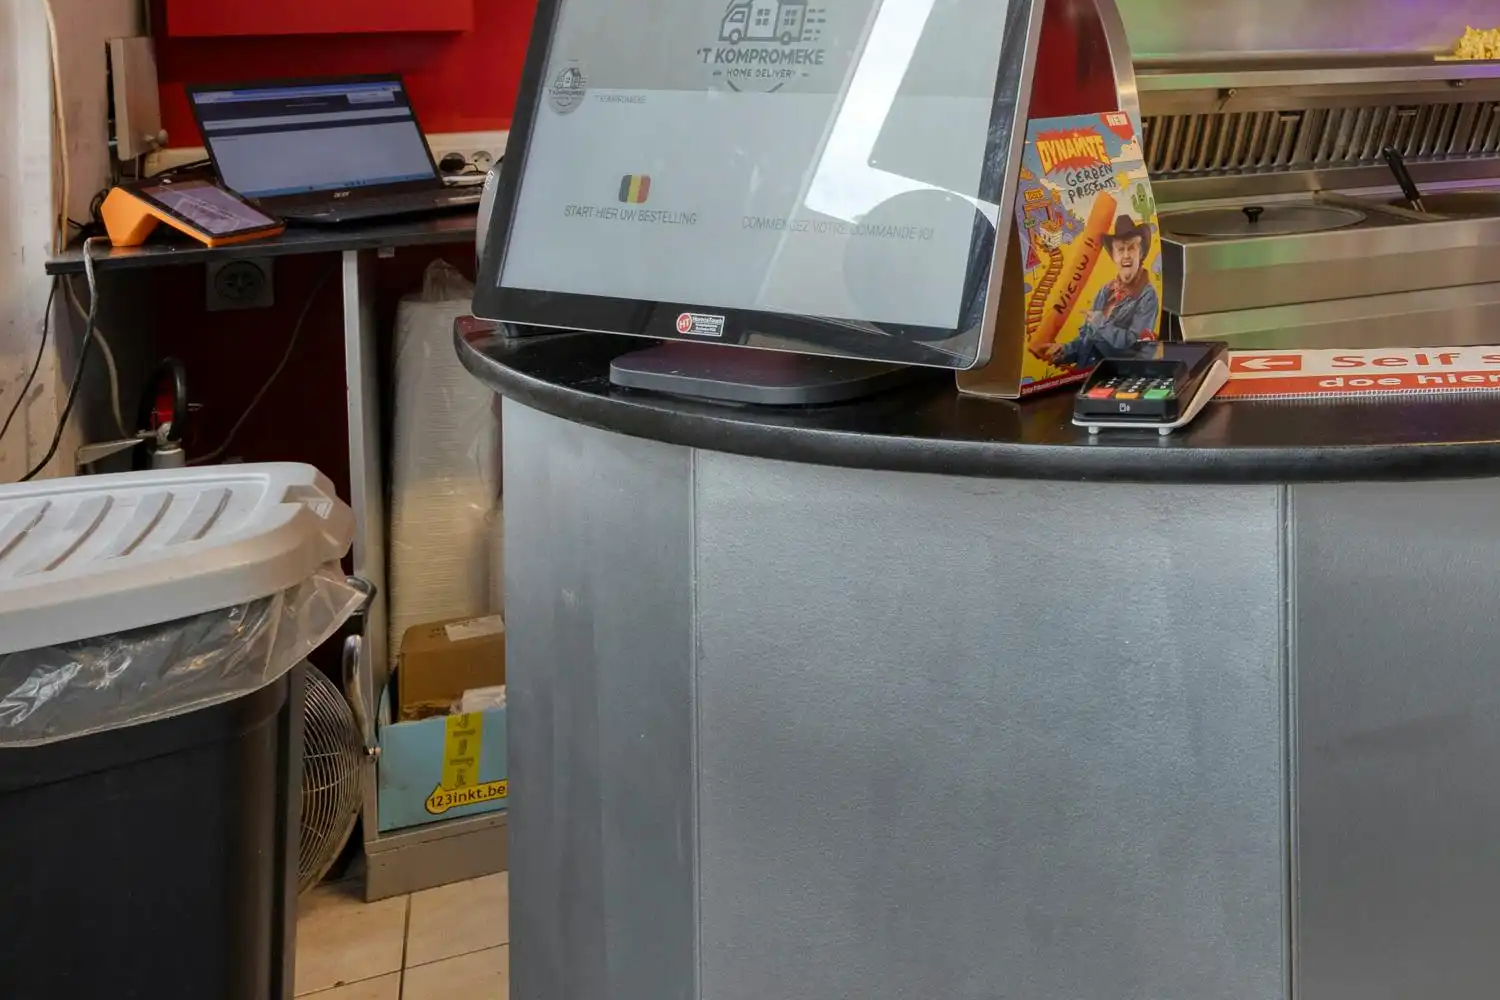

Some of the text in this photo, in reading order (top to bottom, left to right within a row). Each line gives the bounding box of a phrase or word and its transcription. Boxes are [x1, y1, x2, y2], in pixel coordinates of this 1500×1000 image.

[714, 48, 826, 66] KOMPROMIEKE
[726, 68, 797, 79] HOME DELIVERY
[1035, 132, 1112, 176] DYNAMITE
[1065, 164, 1114, 187] GERBEN
[1067, 176, 1117, 204] PRESENTS
[564, 204, 697, 225] START HIER UW BESTELLING
[742, 216, 811, 233] COMMENCEZ
[813, 219, 848, 234] VOTRE
[849, 222, 916, 240] COMMANDE
[1331, 351, 1462, 369] Self
[1317, 375, 1385, 388] doe
[429, 783, 506, 809] 123inkt.be
